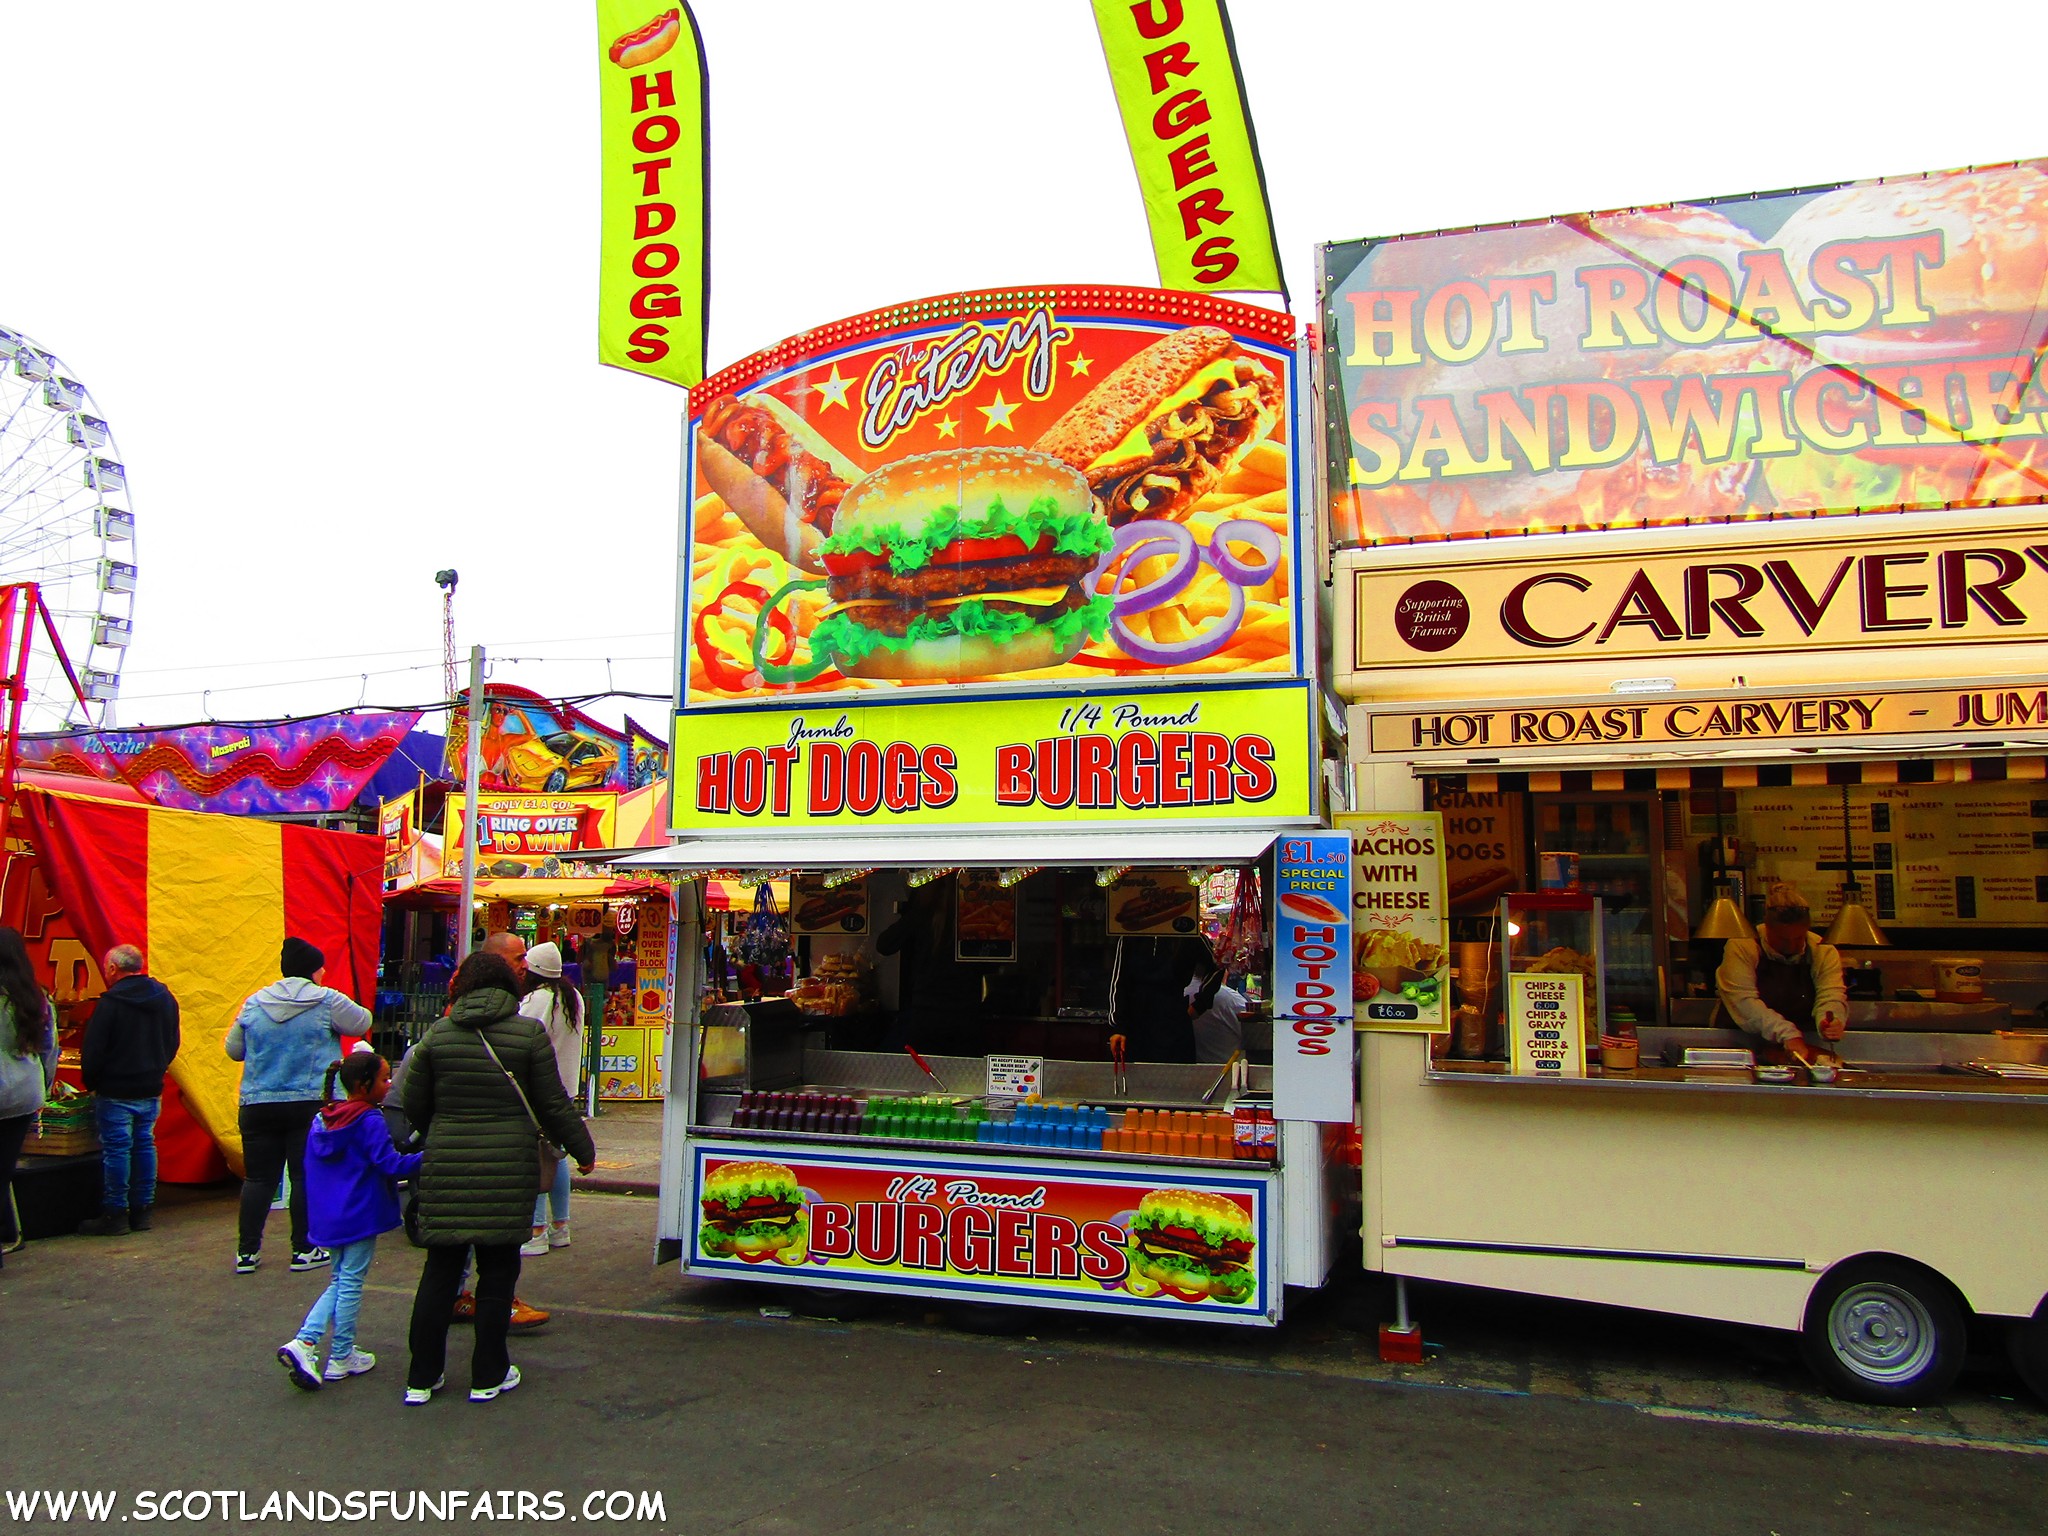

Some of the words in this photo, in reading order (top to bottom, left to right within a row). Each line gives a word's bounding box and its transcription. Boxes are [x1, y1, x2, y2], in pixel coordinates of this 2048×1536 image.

[1346, 270, 1557, 368] HOT
[1579, 229, 1945, 350] ROAST
[893, 342, 929, 370] The
[862, 308, 1068, 447] Eatery
[1348, 349, 2048, 489] SANDWICHE
[1399, 596, 1464, 613] Supporting
[1500, 544, 2048, 650] CARVER
[1413, 610, 1452, 623] British
[1407, 625, 1458, 640] Farmers
[1059, 703, 1102, 732] 1/4
[1112, 702, 1202, 728] Pound
[1412, 713, 1496, 747] HOT
[1511, 707, 1650, 743] ROAST
[1664, 697, 1884, 738] CARVERY
[788, 715, 855, 749] Jumbo
[82, 735, 146, 755] Porsche
[211, 736, 251, 758] Maserati
[695, 742, 800, 817] HOT
[807, 740, 959, 817] DOGS
[995, 730, 1278, 810] BURGERS
[493, 800, 521, 810] ONLY
[523, 799, 537, 809] £1
[540, 800, 548, 809] A
[551, 800, 571, 810] GO!
[1436, 791, 1507, 809] GIANT
[477, 816, 493, 846] 1
[490, 816, 531, 832] RING
[535, 816, 578, 832] OVER
[1450, 816, 1496, 834] HOT
[492, 831, 521, 853] TO
[525, 831, 572, 852] WIN
[1280, 868, 1345, 879] SPECIAL
[1362, 865, 1418, 882] WITH
[1290, 881, 1335, 891] PRICE
[1353, 891, 1430, 909] CHEESE
[618, 905, 632, 923] £1
[642, 930, 664, 939] RING
[641, 940, 665, 948] OVER
[644, 949, 661, 957] THE
[639, 958, 665, 967] BLOCK
[646, 968, 658, 976] TO
[639, 976, 666, 991] WIN
[1525, 981, 1557, 991] CHIPS
[1558, 981, 1567, 991] &
[1526, 991, 1565, 1000] CHEESE
[1526, 1010, 1558, 1020] CHIPS
[1559, 1010, 1568, 1020] &
[1528, 1020, 1566, 1030] GRAVY
[1526, 1039, 1559, 1049] CHIPS
[1560, 1039, 1569, 1049] &
[1530, 1049, 1566, 1059] CURRY
[886, 1175, 937, 1202] 1/4
[945, 1180, 1047, 1209] Pound
[808, 1201, 1131, 1283] BURGERS
